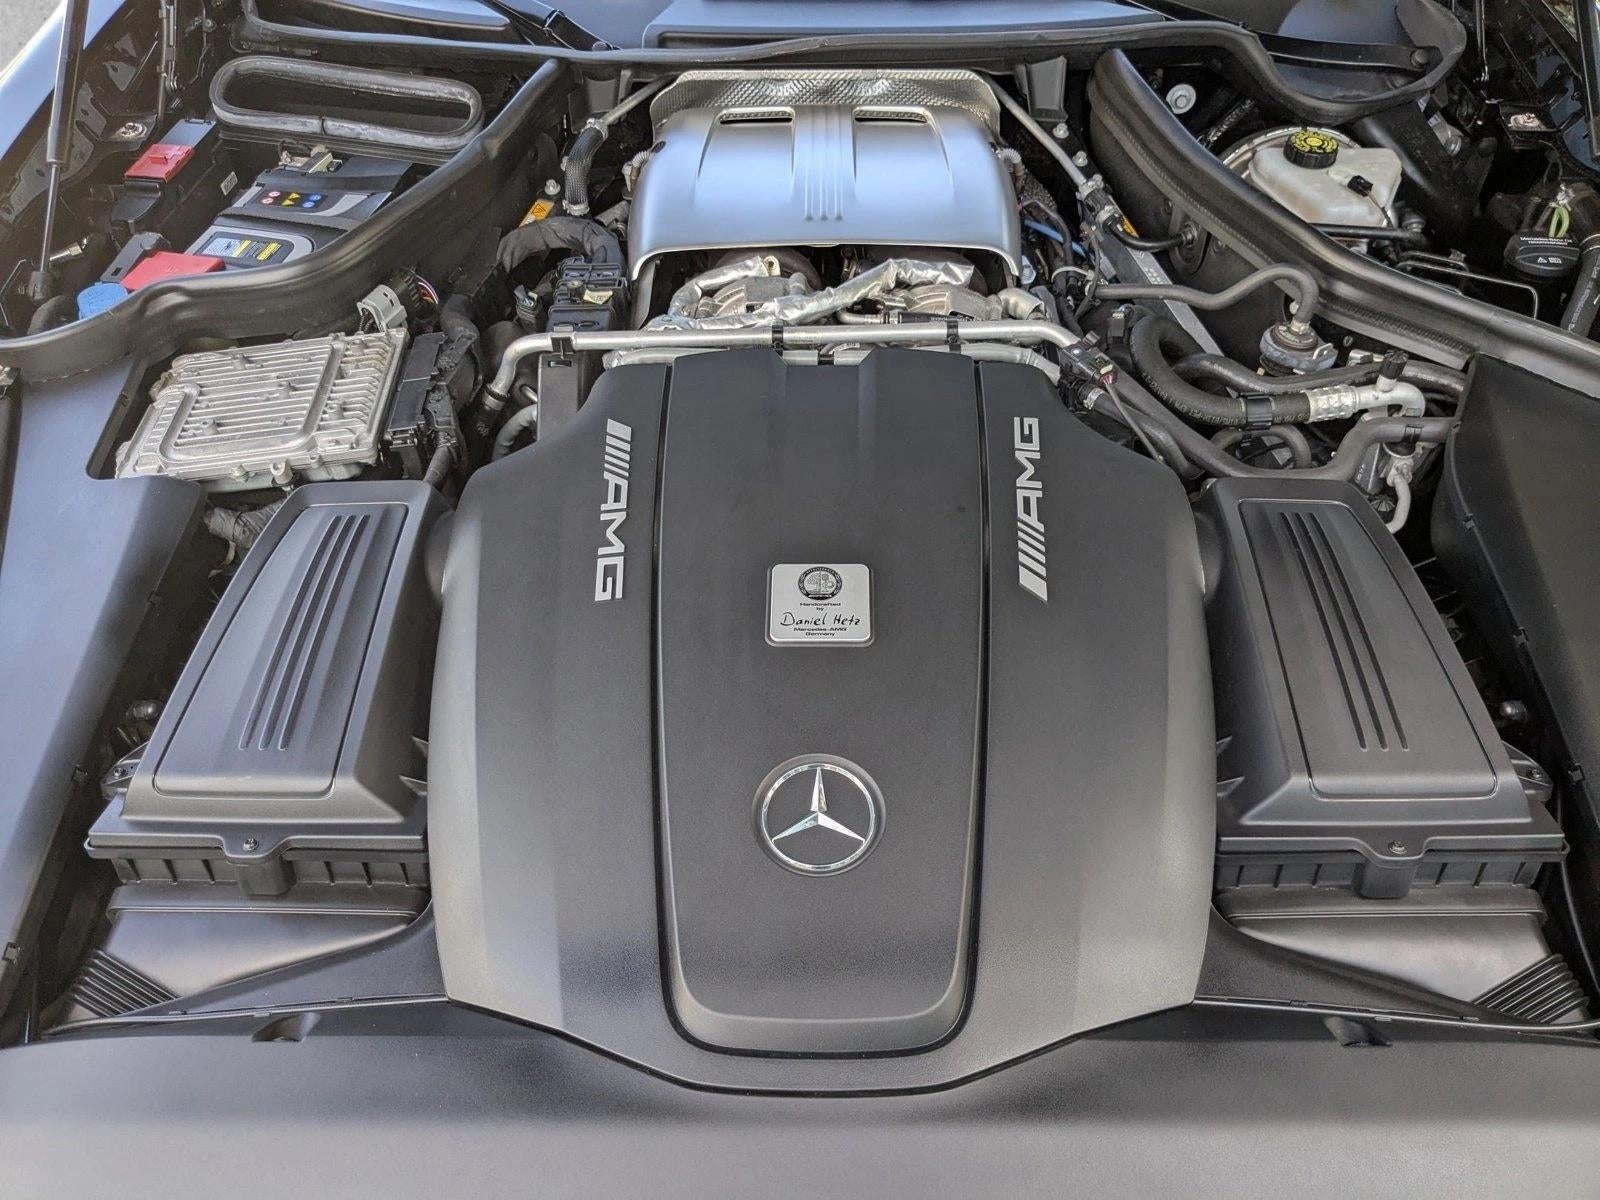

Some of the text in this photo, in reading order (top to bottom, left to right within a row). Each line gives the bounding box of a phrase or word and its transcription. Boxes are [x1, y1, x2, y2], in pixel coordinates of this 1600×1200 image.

[1014, 416, 1045, 533] AMG
[595, 470, 629, 602] AMG
[780, 611, 828, 626] Daniel
